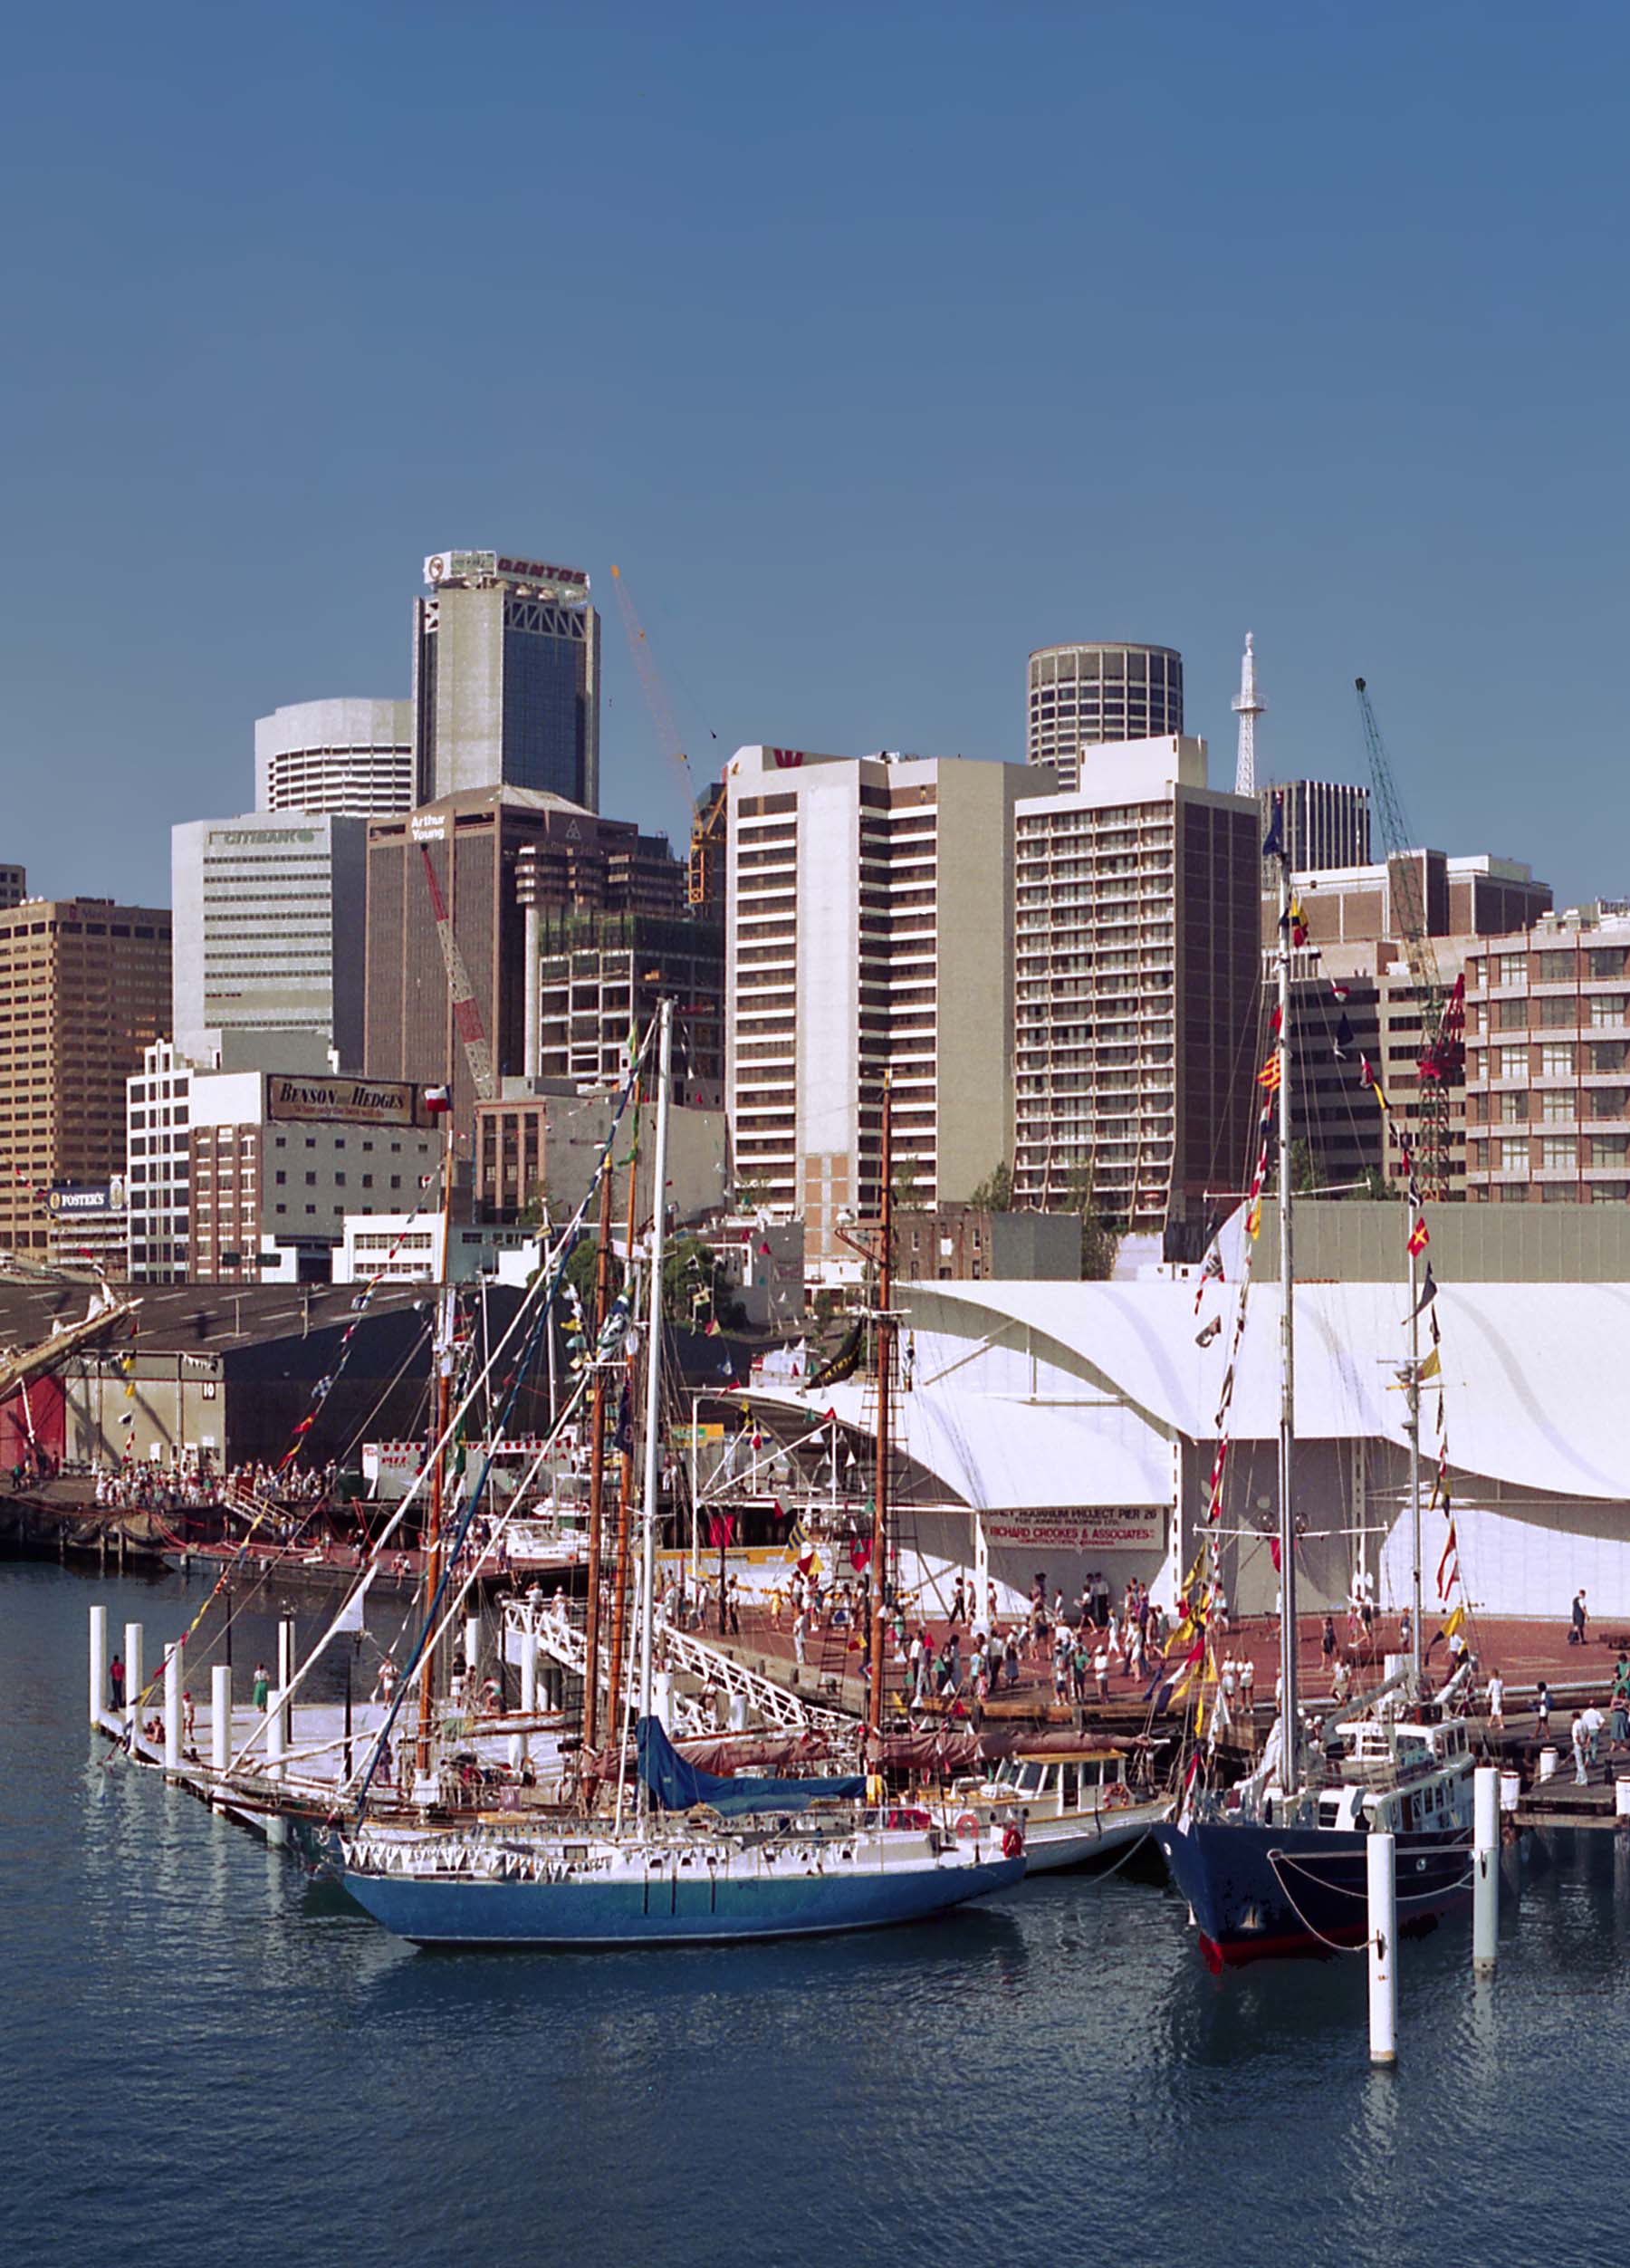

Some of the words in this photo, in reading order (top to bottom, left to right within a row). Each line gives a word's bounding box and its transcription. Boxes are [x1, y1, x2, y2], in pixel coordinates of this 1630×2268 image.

[497, 557, 586, 584] QANTAS
[411, 814, 445, 827] Arthur
[224, 831, 296, 844] CITIBANK
[412, 828, 445, 841] Young
[280, 1082, 337, 1104] BENSON
[351, 1086, 404, 1110] HEDGES
[204, 1383, 215, 1397] 10
[1071, 1508, 1115, 1518] PROJECT
[1119, 1508, 1140, 1519] PIER
[990, 1526, 1031, 1537] RICHARD
[1032, 1527, 1079, 1538] CROOKES
[1092, 1528, 1150, 1539] ASSOCIATES
